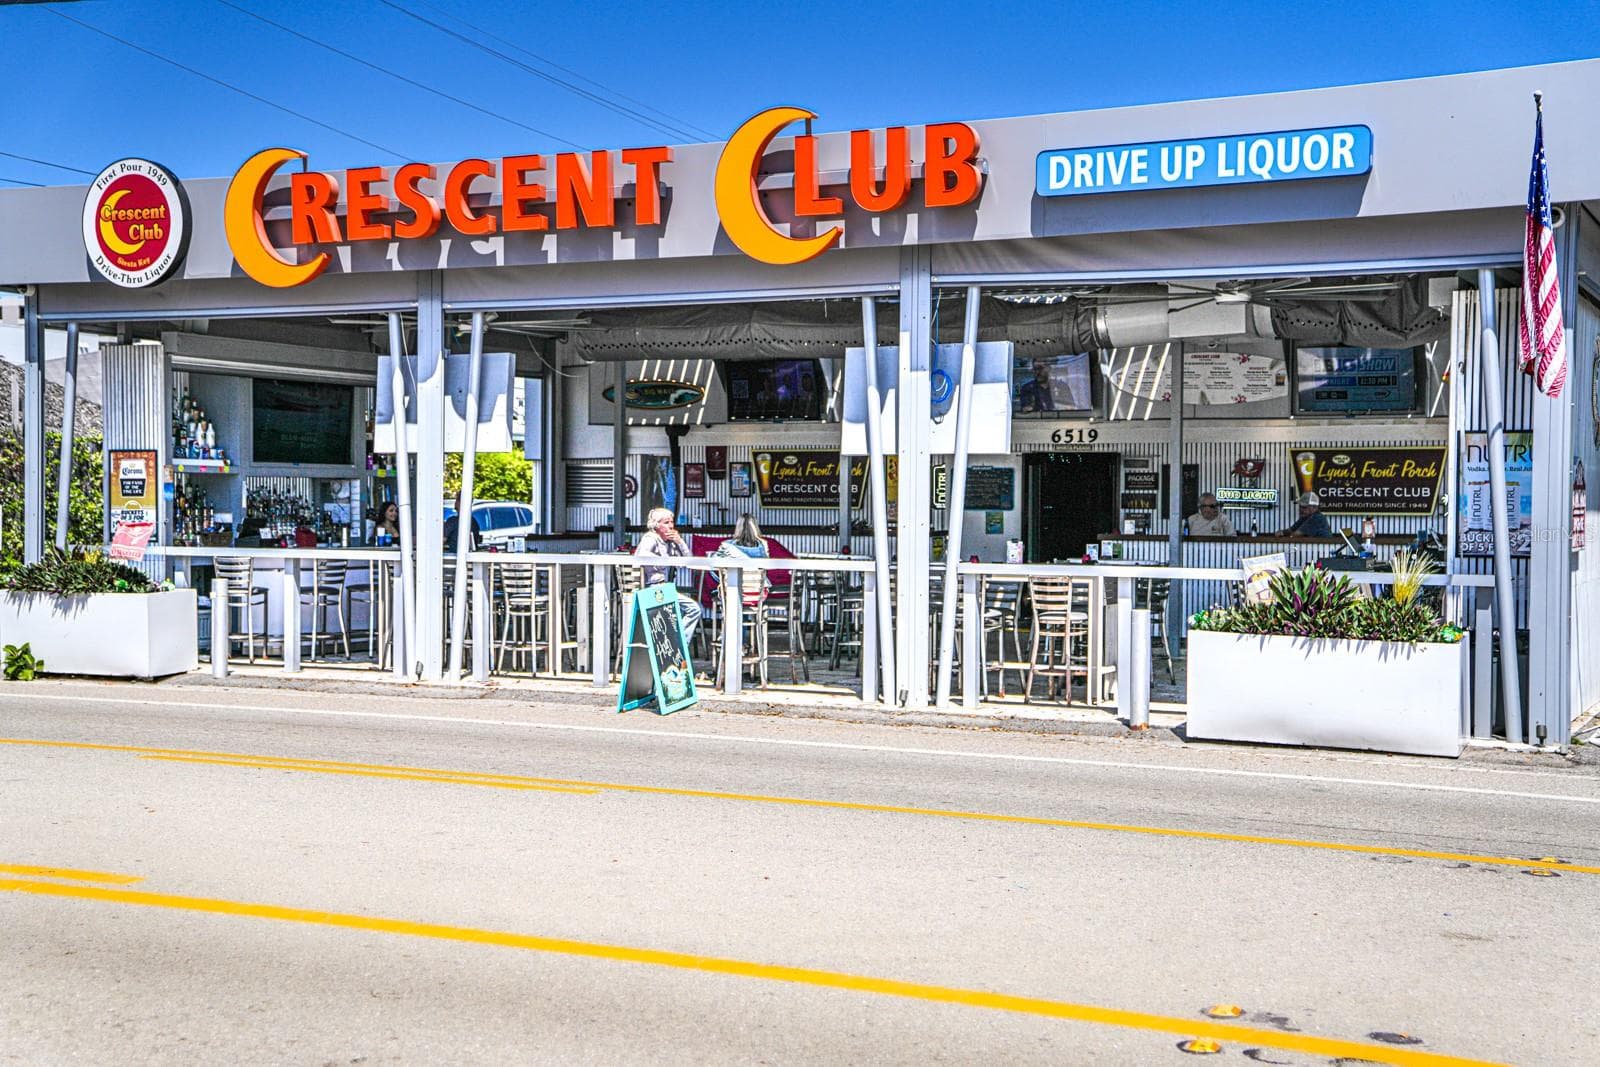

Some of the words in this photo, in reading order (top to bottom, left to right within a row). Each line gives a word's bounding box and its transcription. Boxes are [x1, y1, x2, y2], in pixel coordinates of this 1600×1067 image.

[1049, 149, 1148, 190] DRIVE
[1160, 144, 1206, 182] UP
[1217, 132, 1355, 180] LIQUOR
[96, 169, 117, 190] First
[120, 163, 142, 173] Pour
[147, 166, 168, 186] 1949
[224, 147, 674, 288] CRESCENT
[715, 106, 981, 264] CLUB
[100, 204, 166, 222] Crescent
[128, 223, 164, 241] Club
[95, 255, 143, 284] Drive-Thru
[145, 254, 172, 281] Liquor
[138, 257, 151, 266] Key
[1360, 358, 1395, 371] SHOW
[1051, 428, 1098, 443] 6519
[122, 467, 143, 476] Corona
[772, 461, 802, 479] Lynn's
[805, 461, 835, 476] Front
[1317, 460, 1357, 481] Lynn's
[1361, 460, 1400, 478] Front
[1401, 459, 1437, 478] Porch
[773, 484, 827, 493] CRESCENT
[830, 484, 858, 493] CB
[1218, 490, 1242, 499] BUD
[1242, 490, 1275, 500] LIGHT
[1318, 487, 1390, 497] CRESCENT
[1393, 487, 1431, 497] CLUB
[1461, 533, 1494, 542] BUCK
